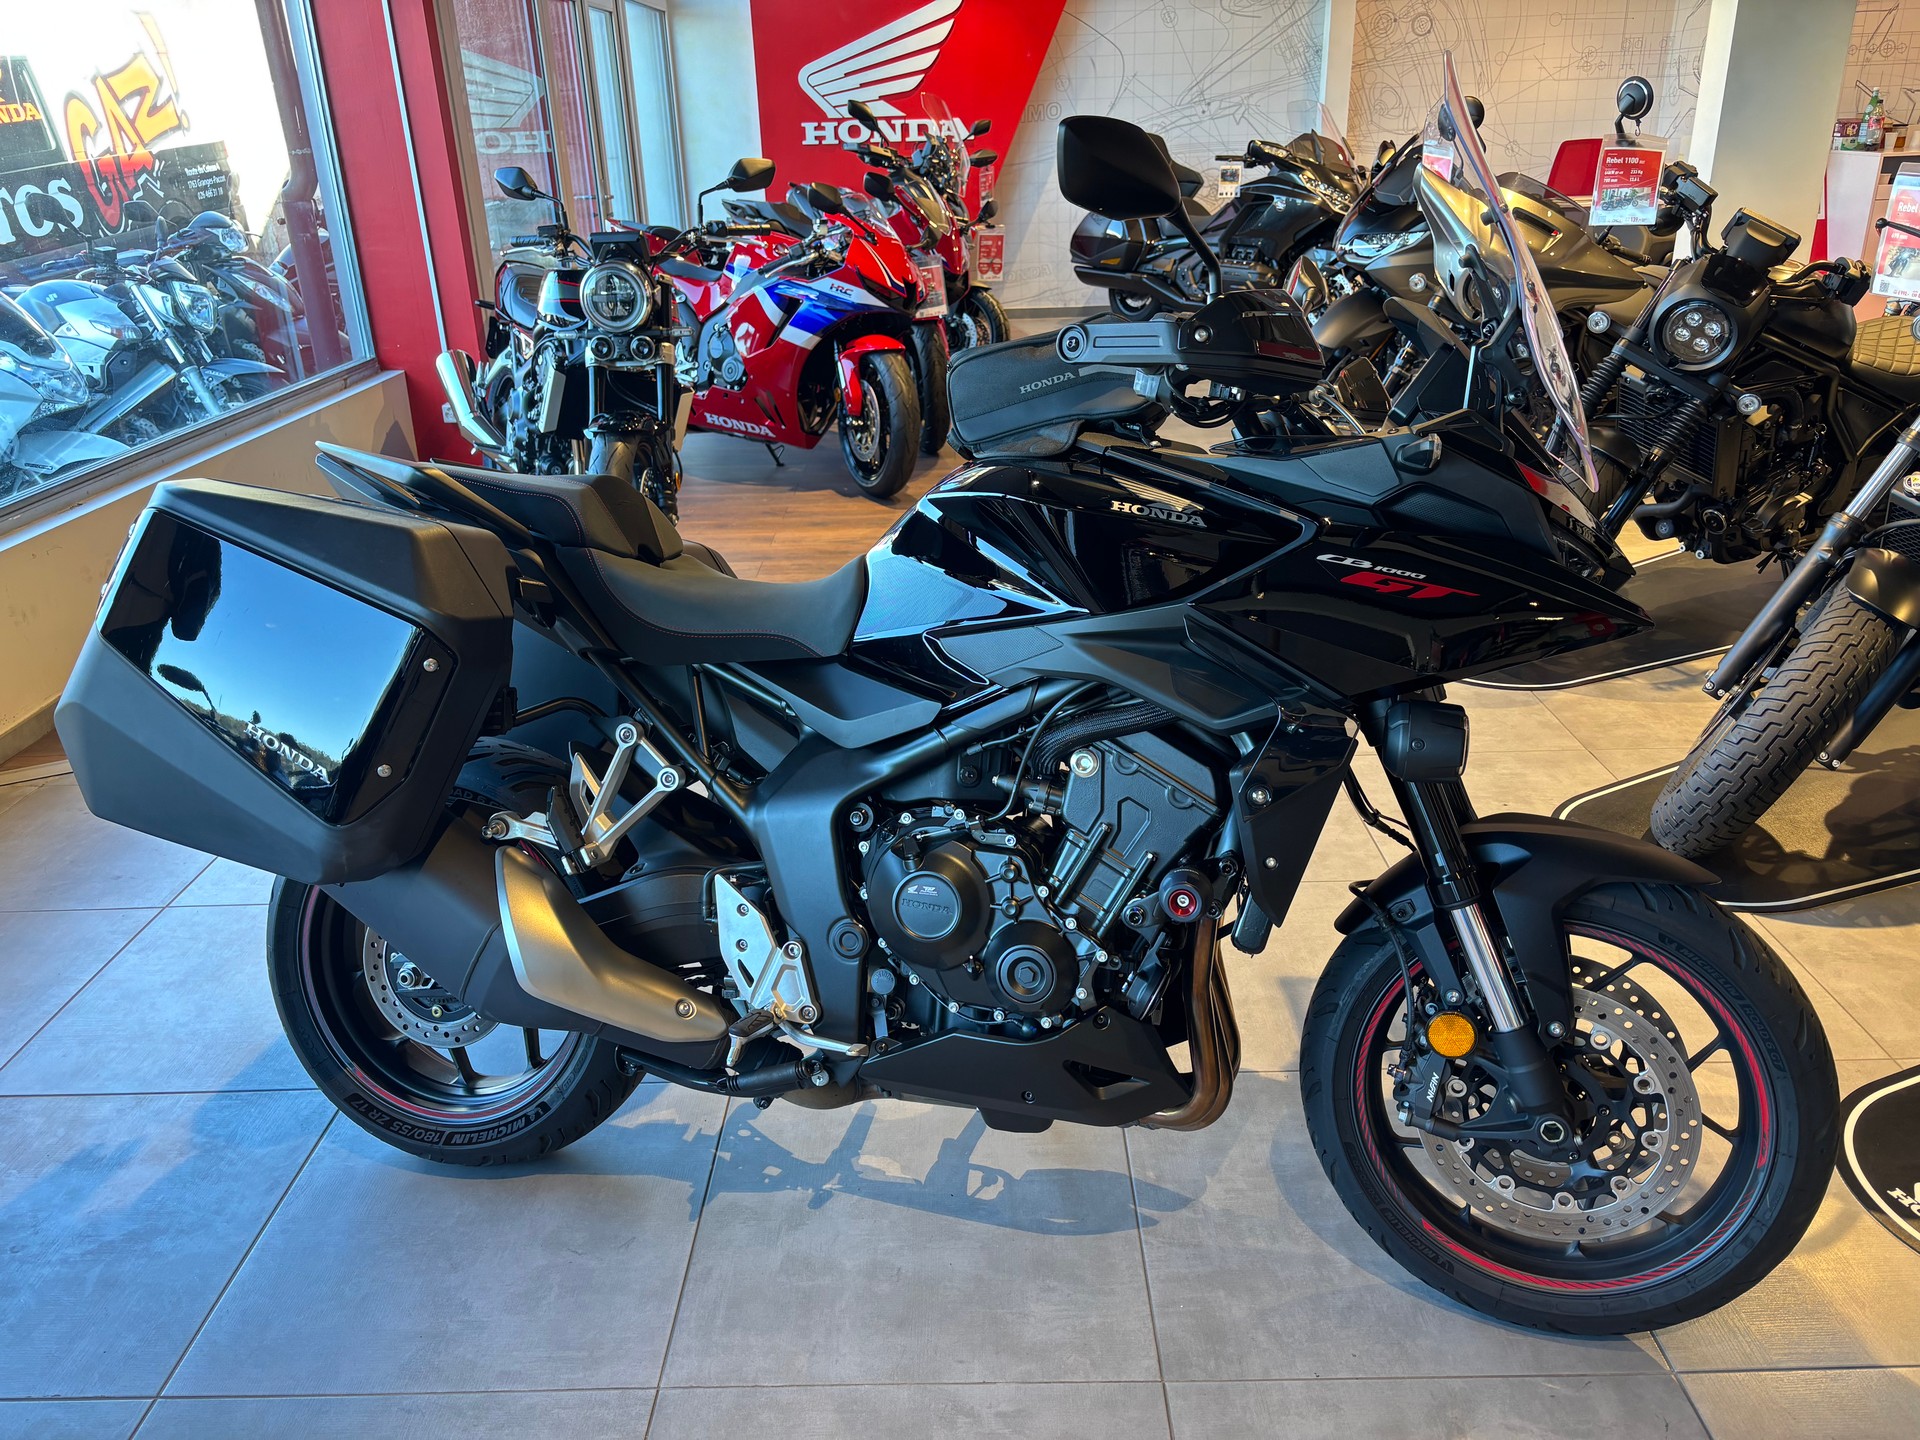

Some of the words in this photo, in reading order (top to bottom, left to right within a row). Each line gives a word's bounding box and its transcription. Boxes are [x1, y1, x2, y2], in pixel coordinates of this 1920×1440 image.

[801, 117, 975, 146] HONDA
[1605, 156, 1624, 164] Rebel
[1625, 156, 1639, 164] 1100
[1897, 201, 1919, 213] Rebel
[1005, 263, 1053, 283] ONDA
[829, 283, 854, 296] HRC
[1019, 371, 1076, 394] HONDA
[704, 412, 776, 438] HONDA
[1110, 500, 1208, 528] HONDA
[1340, 571, 1481, 599] GT
[243, 721, 331, 785] HONDA
[902, 898, 954, 915] HONDA
[1680, 947, 1739, 998] MICHELIN
[1743, 1005, 1770, 1036] ROAD
[353, 1099, 370, 1114] 17
[368, 1109, 388, 1126] ZR
[389, 1120, 441, 1144] 180/55
[450, 1117, 526, 1144] MICHELIN
[1381, 1206, 1436, 1259] MICHELIN
